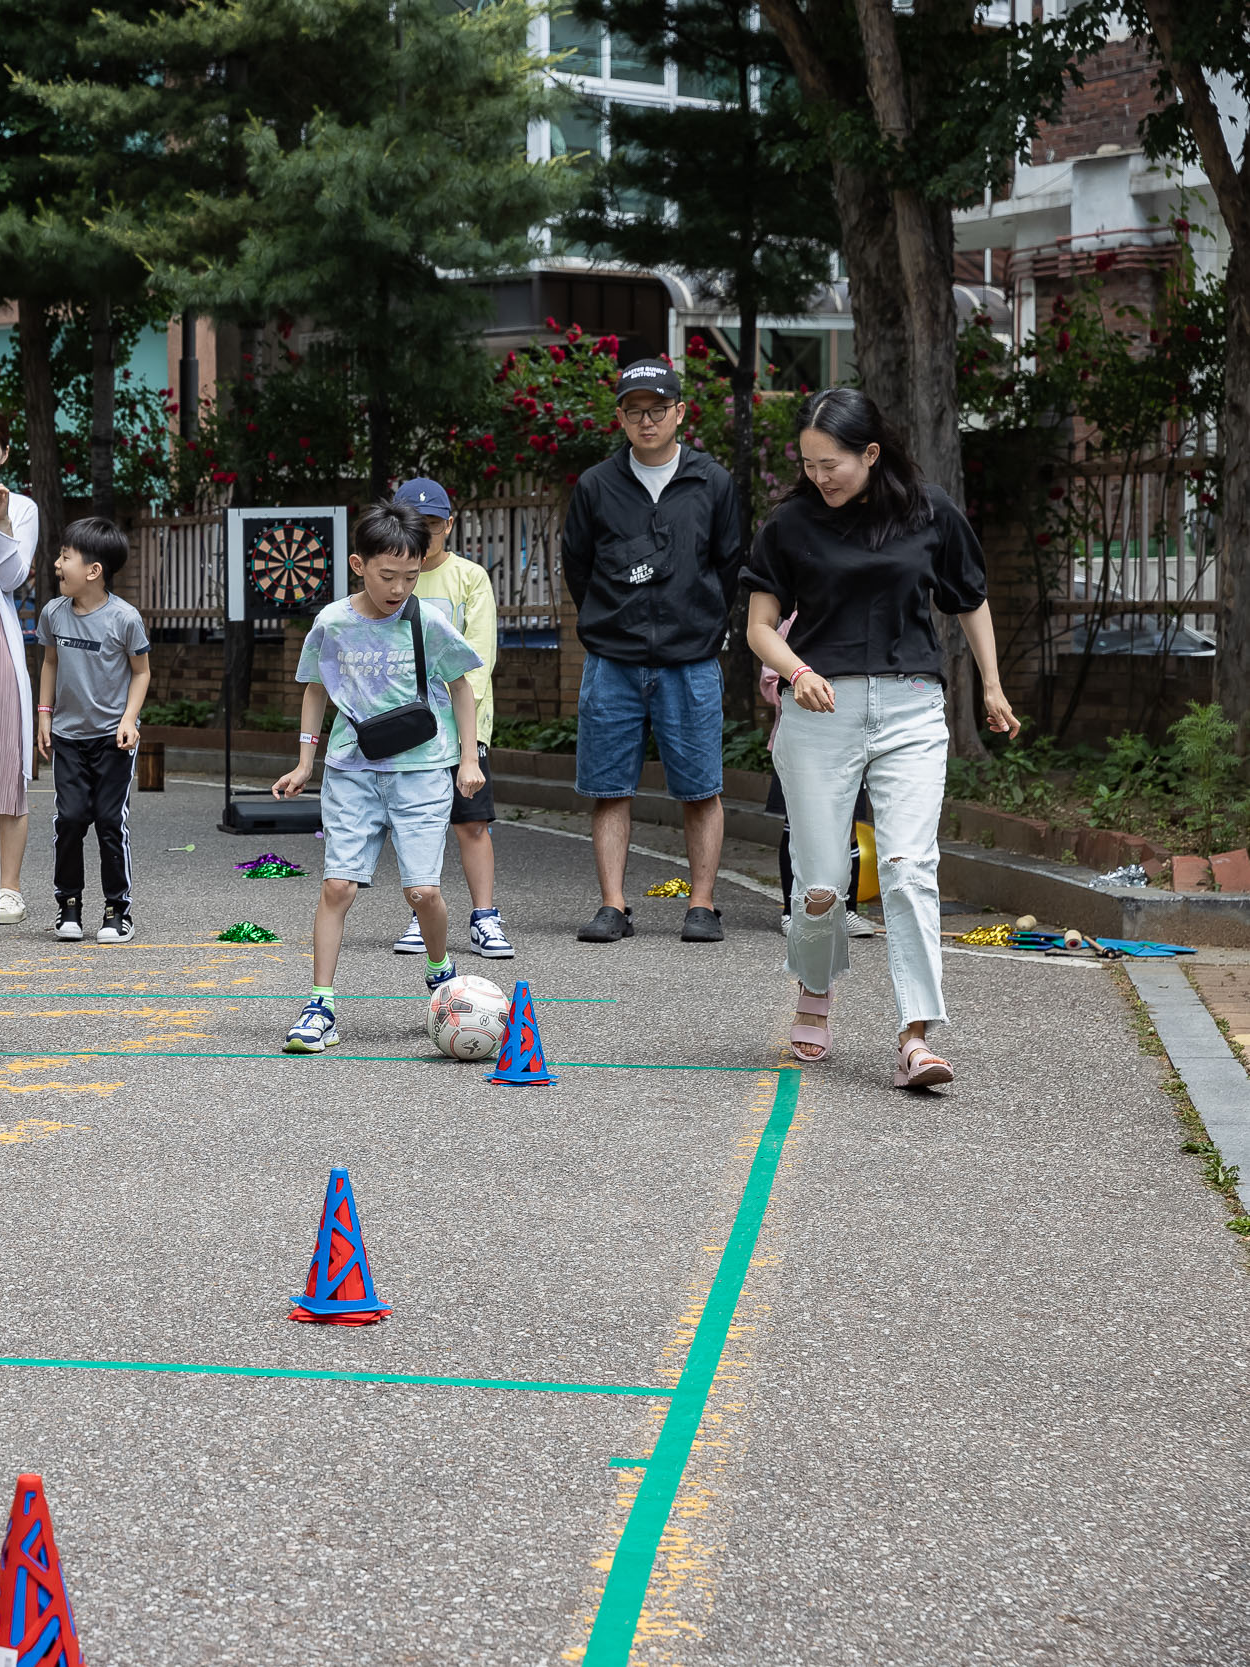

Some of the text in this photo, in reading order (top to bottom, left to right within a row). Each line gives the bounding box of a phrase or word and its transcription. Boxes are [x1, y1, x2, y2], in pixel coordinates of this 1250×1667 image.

[629, 567, 654, 583] MILLS
[631, 563, 648, 575] LES
[337, 649, 415, 664] HAPPY MIN
[339, 662, 416, 677] HAPPY LIF
